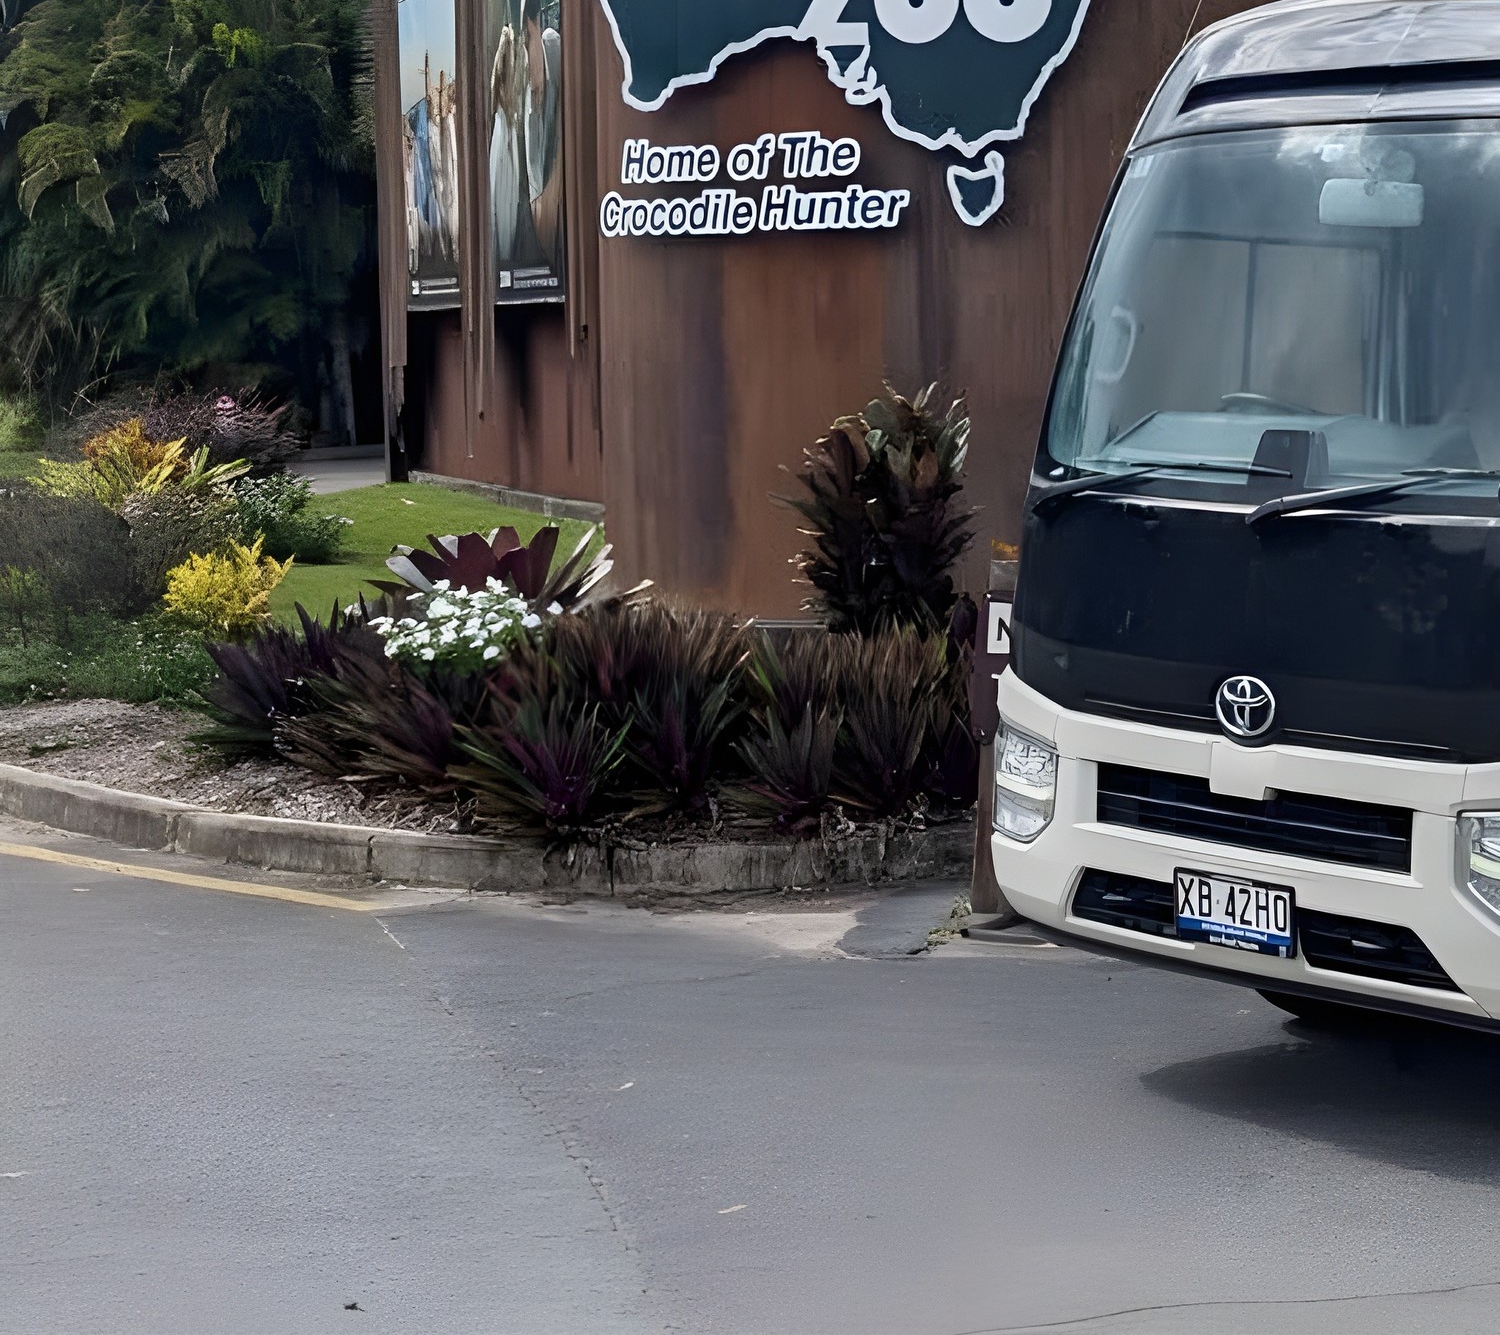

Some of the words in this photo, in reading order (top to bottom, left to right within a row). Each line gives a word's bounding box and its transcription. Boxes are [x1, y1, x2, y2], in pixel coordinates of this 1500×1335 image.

[621, 139, 718, 184] Home
[728, 133, 776, 181] of
[778, 131, 861, 178] The
[600, 189, 756, 237] Crocodile
[759, 185, 909, 231] Hunter
[1178, 877, 1212, 917] XB
